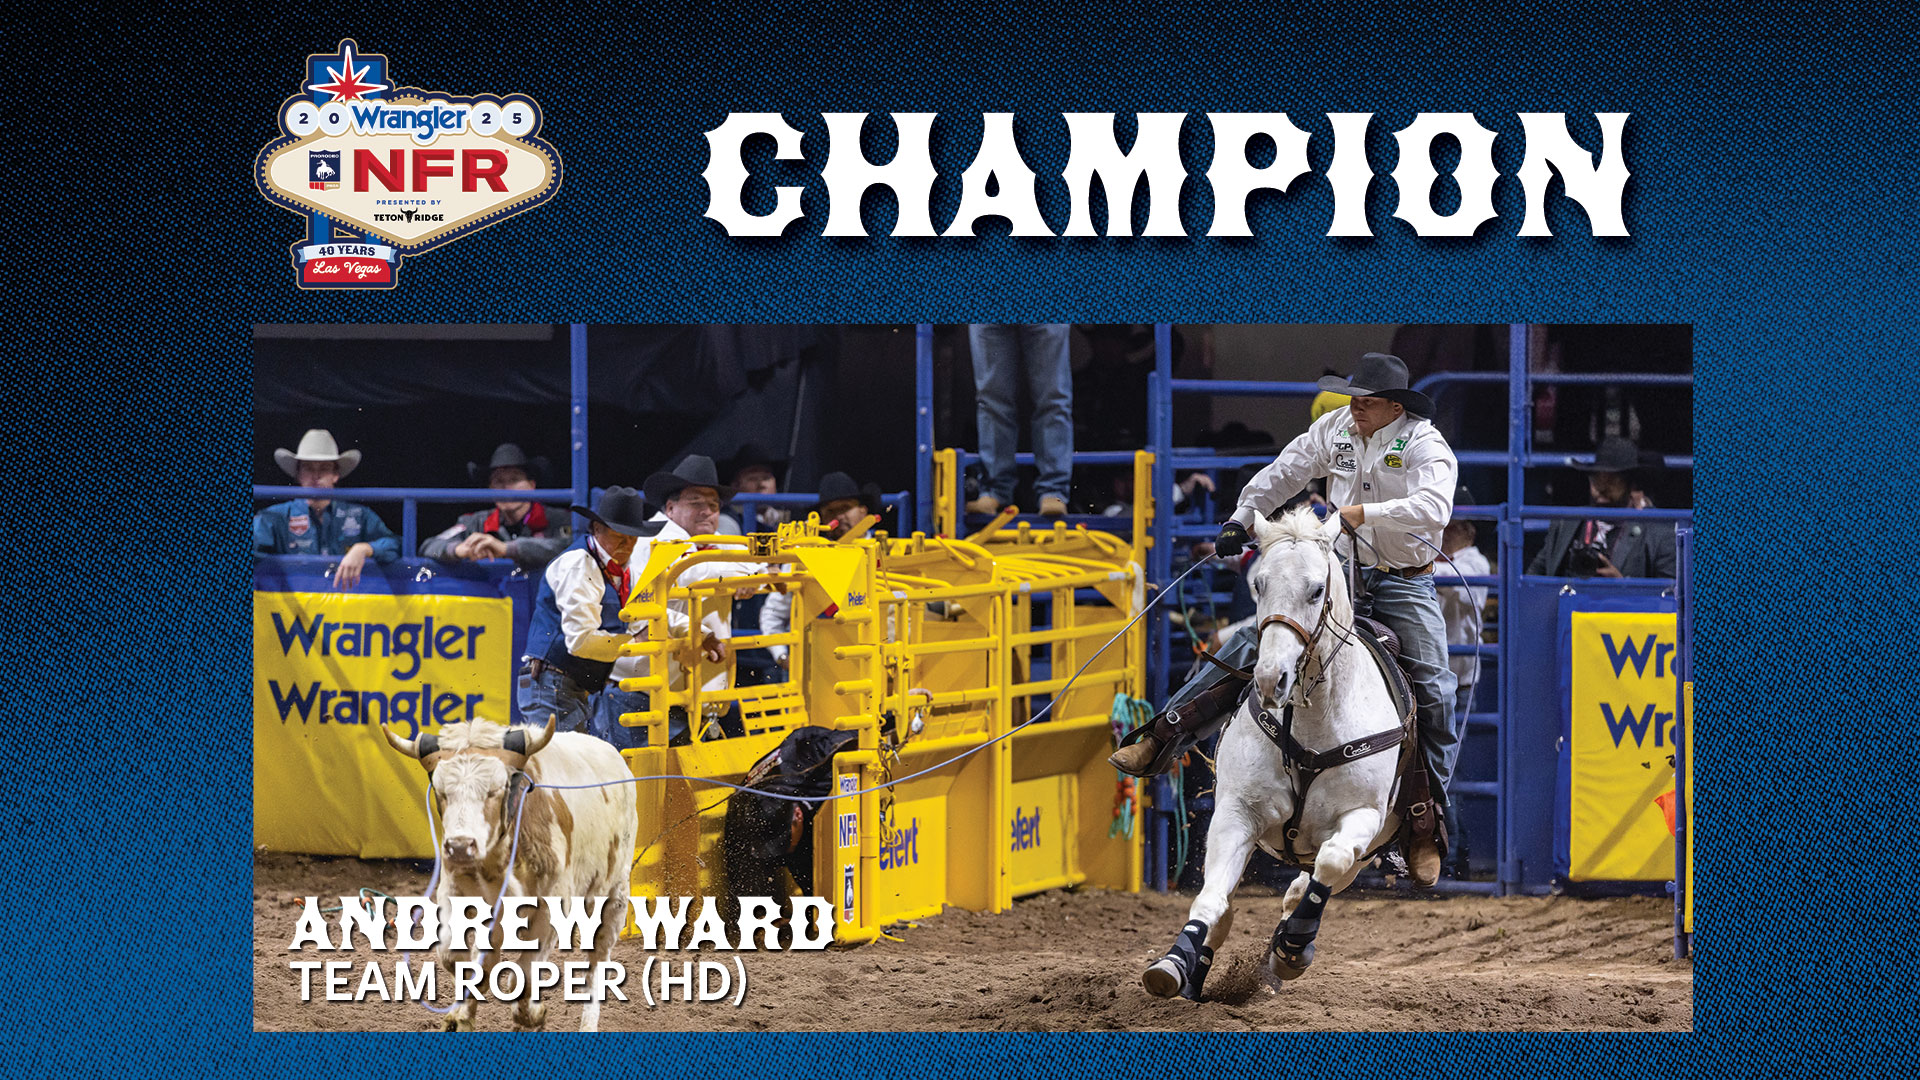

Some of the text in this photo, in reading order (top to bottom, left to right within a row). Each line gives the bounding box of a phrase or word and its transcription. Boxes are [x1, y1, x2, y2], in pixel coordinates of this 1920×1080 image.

[270, 612, 486, 681] Wrangler
[268, 679, 484, 741] Wrangler
[839, 813, 859, 848] NFR
